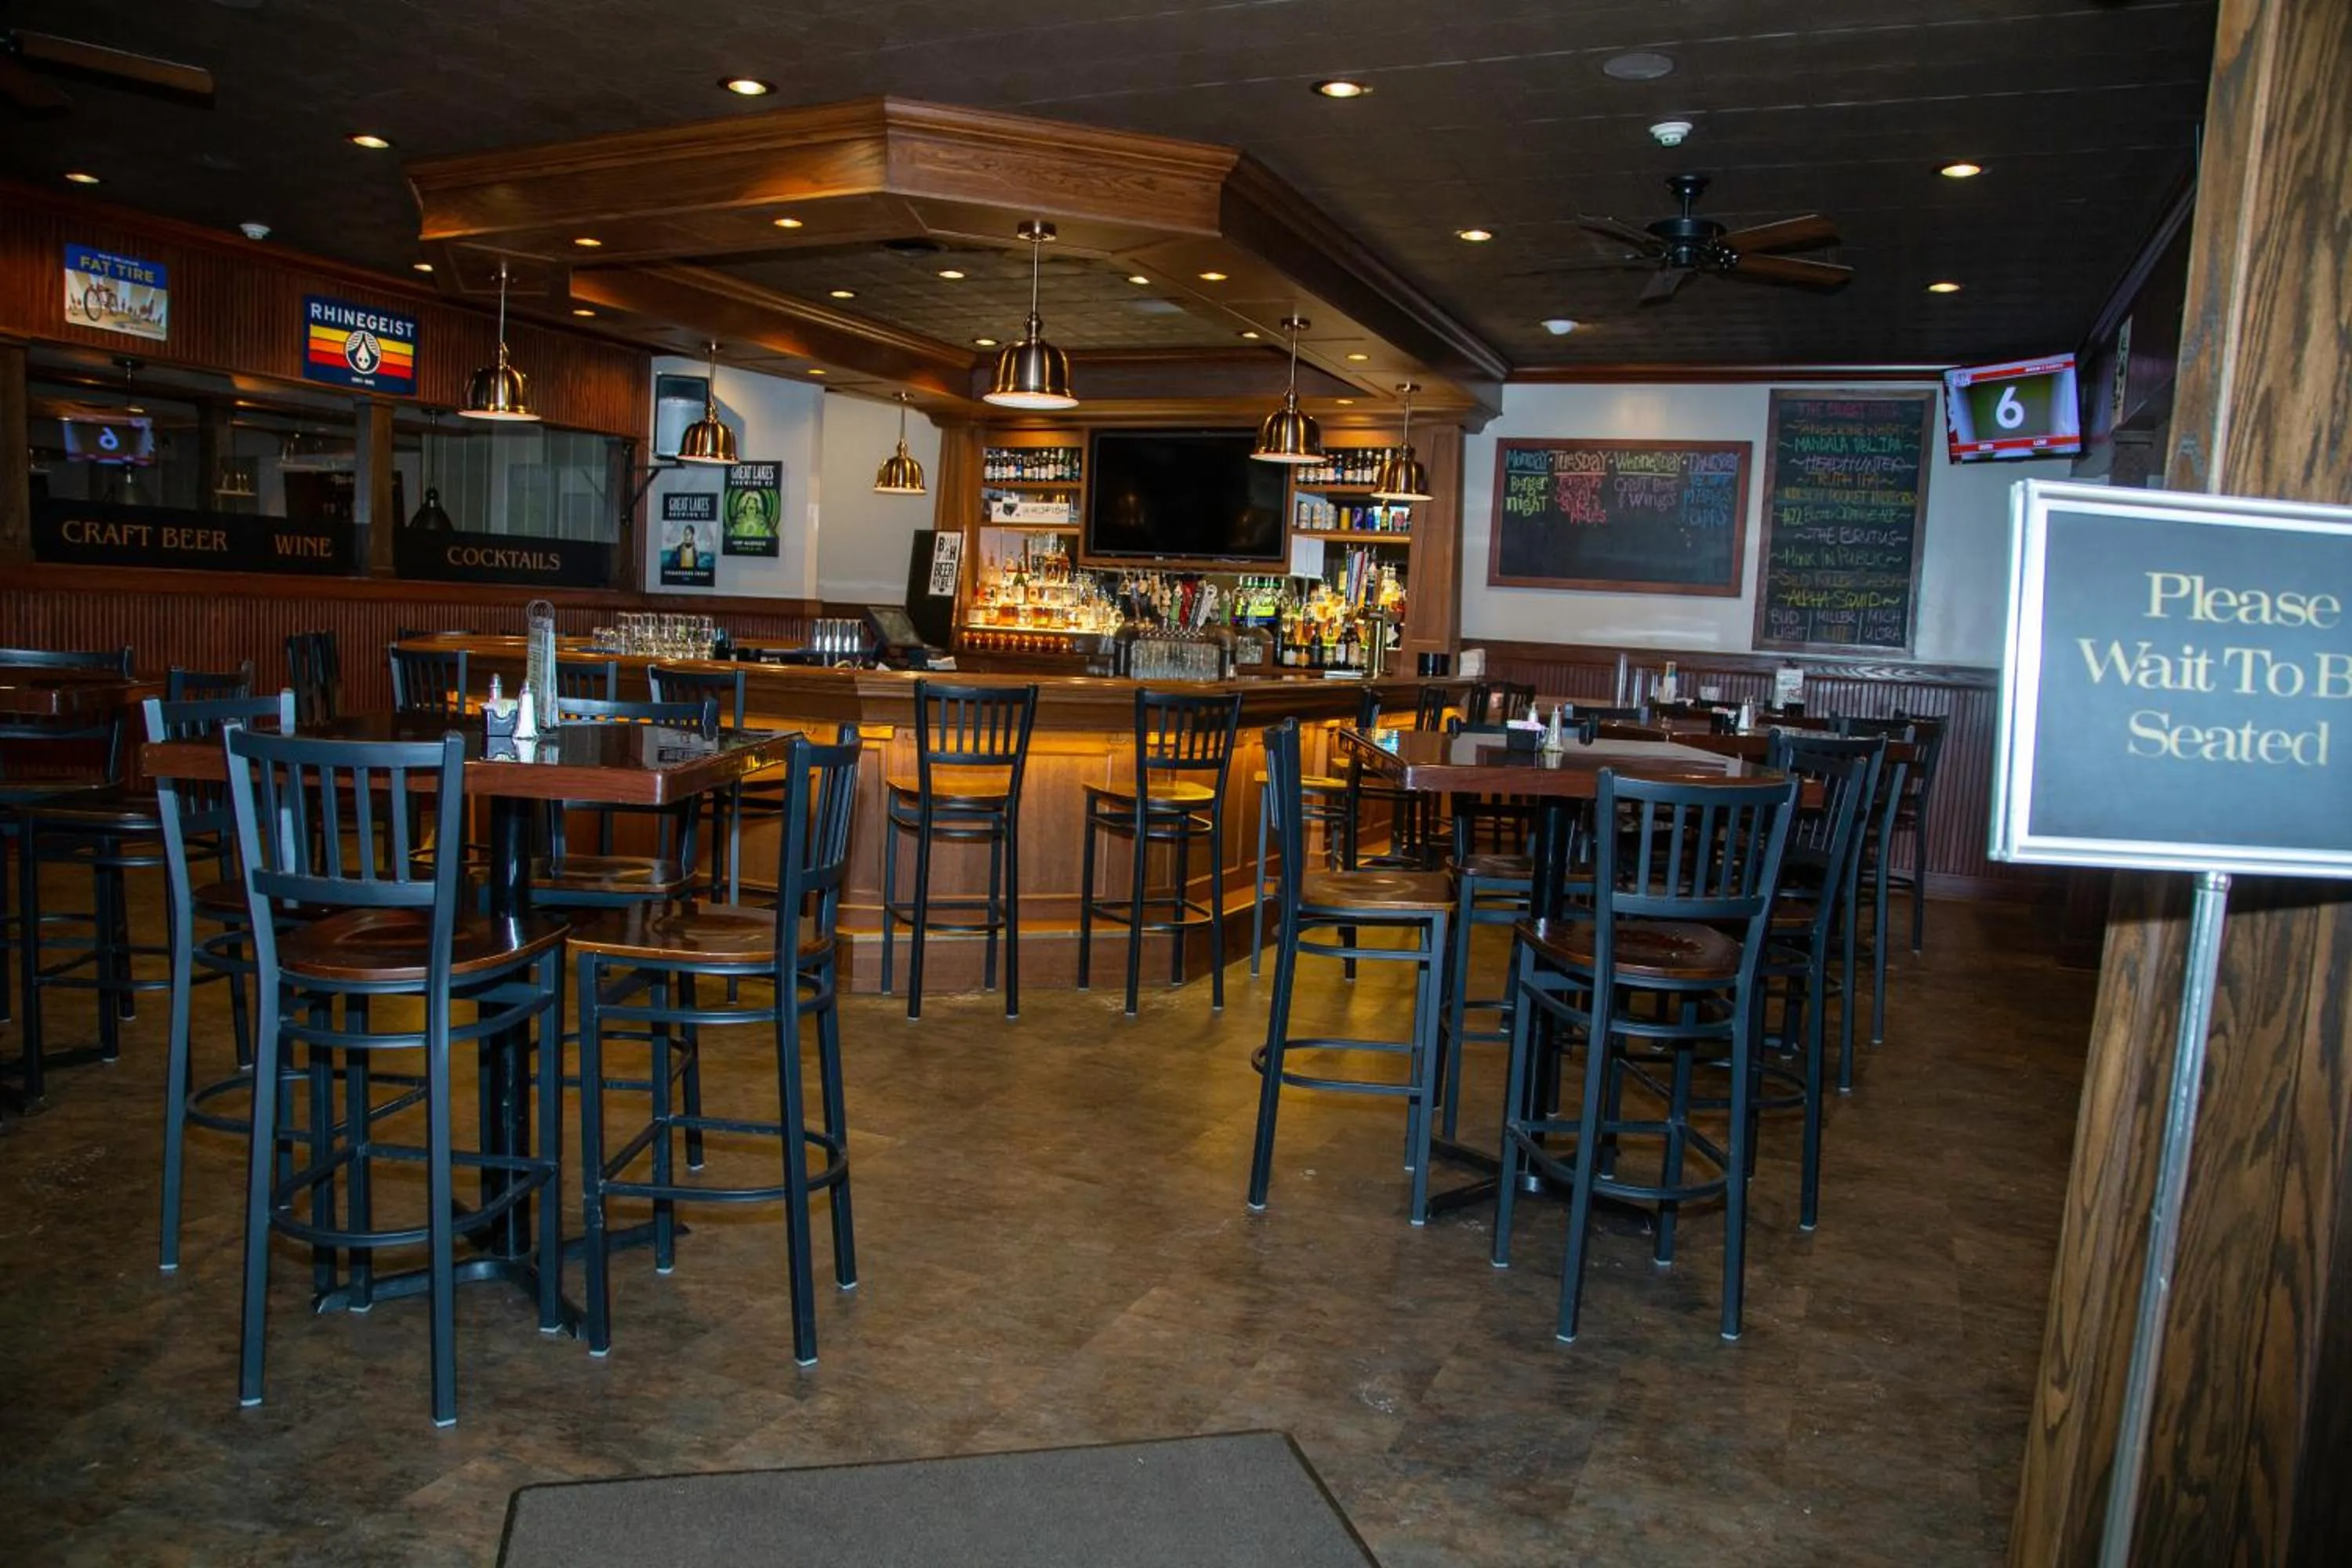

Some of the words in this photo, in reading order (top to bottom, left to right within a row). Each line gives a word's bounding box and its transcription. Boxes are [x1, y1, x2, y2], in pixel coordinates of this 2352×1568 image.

[79, 255, 111, 277] FAT
[116, 264, 155, 283] TIRE
[310, 303, 415, 338] RHINEGEIST
[1996, 387, 2024, 430] 6
[62, 520, 151, 546] CRAFT
[162, 526, 228, 552] BEER
[274, 534, 333, 558] WINE
[1805, 527, 1837, 544] THE
[1841, 527, 1899, 546] BRUTUS
[447, 546, 561, 571] COCKTAILS
[1770, 608, 1800, 625] BUD
[1817, 610, 1857, 624] MILLER
[1867, 609, 1902, 625] MICH
[1834, 591, 1882, 609] SQUID
[2143, 571, 2341, 628] Please
[2074, 637, 2216, 693] Wait
[2223, 646, 2305, 698] To
[2127, 709, 2329, 766] Seated
